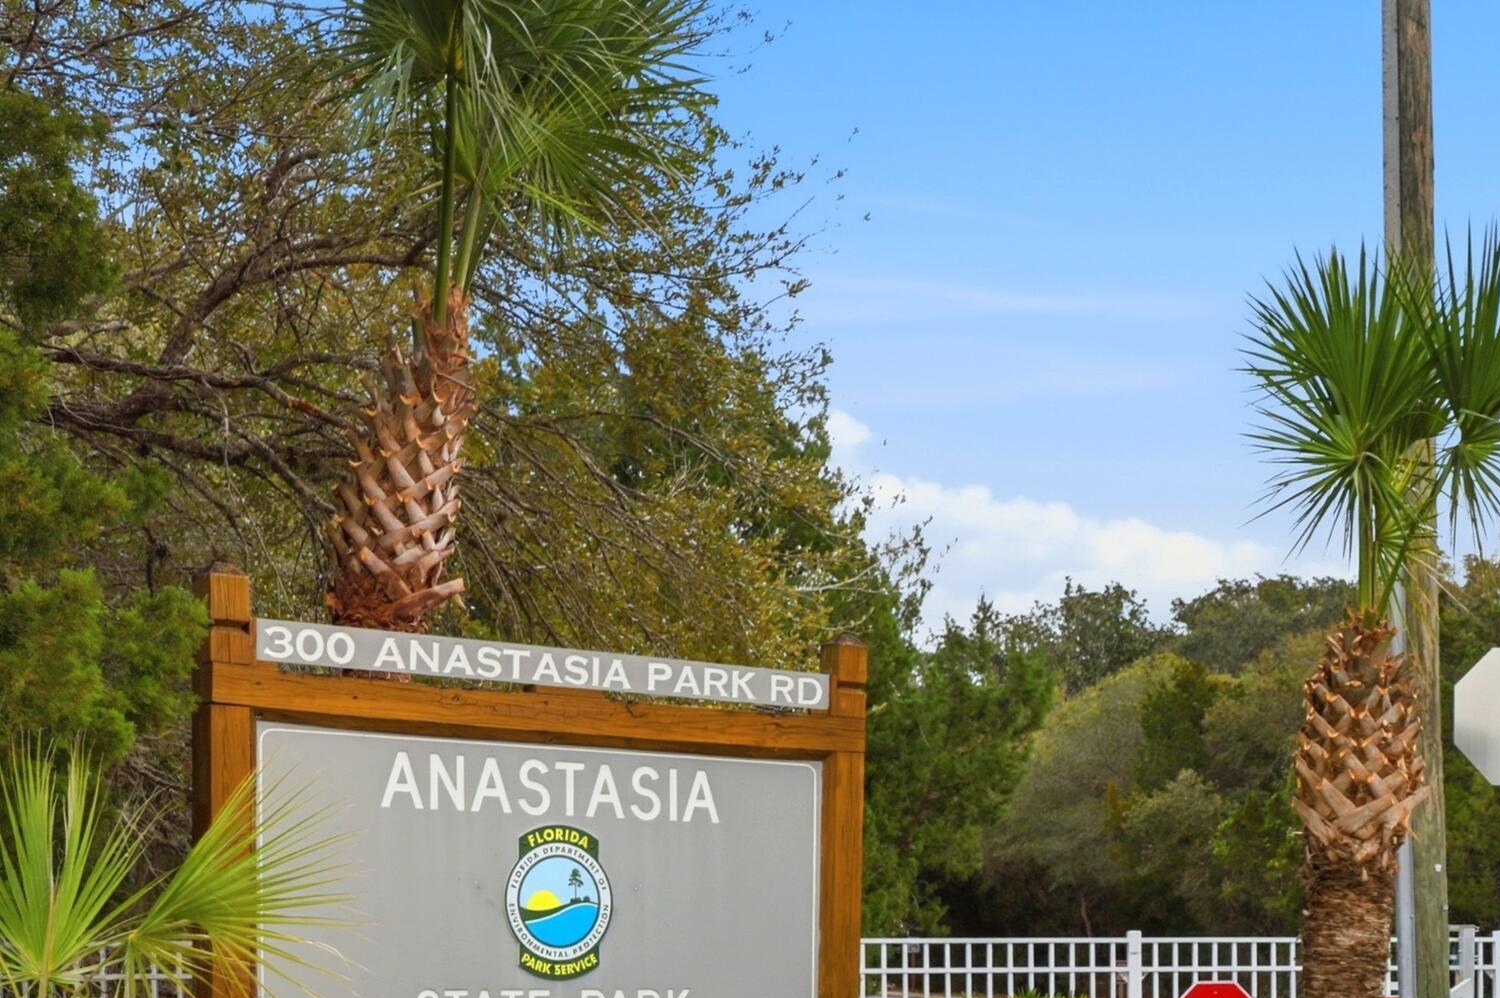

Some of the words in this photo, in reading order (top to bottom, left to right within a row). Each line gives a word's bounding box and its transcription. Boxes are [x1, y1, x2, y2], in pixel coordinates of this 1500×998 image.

[263, 625, 356, 666] 300
[374, 636, 632, 691] ANASTASIA
[648, 662, 756, 701] PARK
[770, 674, 824, 707] RD
[380, 750, 721, 824] ANASTASIA
[527, 828, 589, 849] FLORIDA
[511, 852, 540, 890] FLORIDA
[543, 846, 600, 874] DEPARTMENT
[599, 877, 607, 891] OF
[508, 903, 570, 958] ENVIRONMENTAL
[573, 904, 610, 956] PROTECTION
[521, 953, 552, 975] PARK
[554, 953, 598, 975] SERVICE
